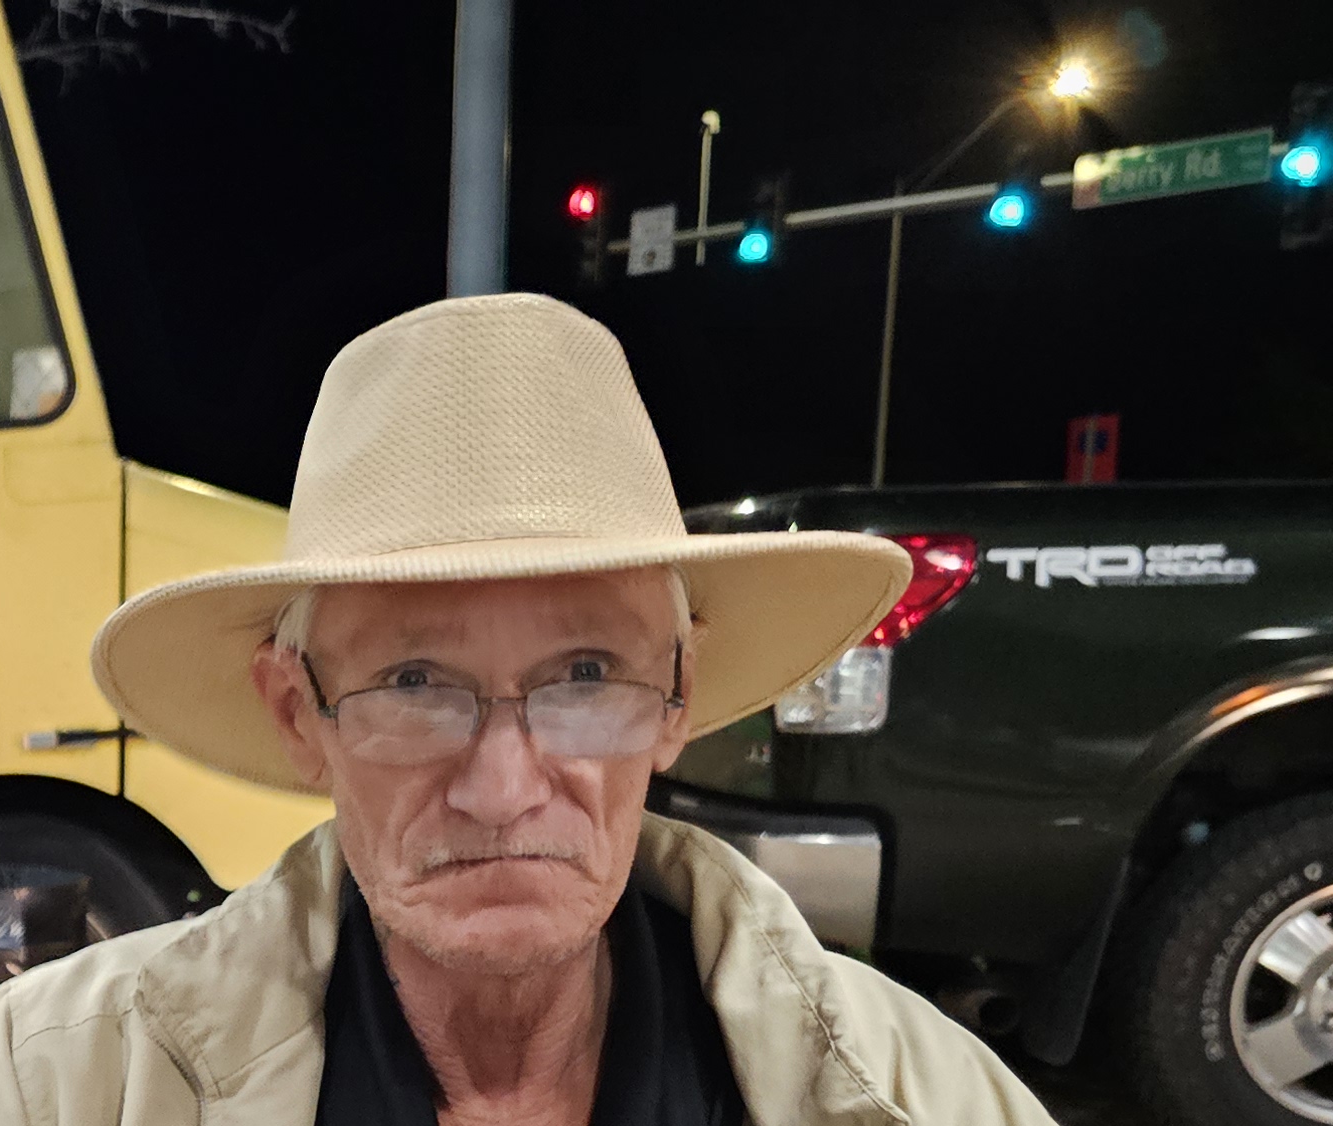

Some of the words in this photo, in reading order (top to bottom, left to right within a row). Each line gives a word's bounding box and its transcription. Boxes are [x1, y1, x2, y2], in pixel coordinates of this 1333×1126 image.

[1145, 544, 1227, 560] OFF
[986, 545, 1144, 588] TRD
[1145, 558, 1256, 577] ROAD
